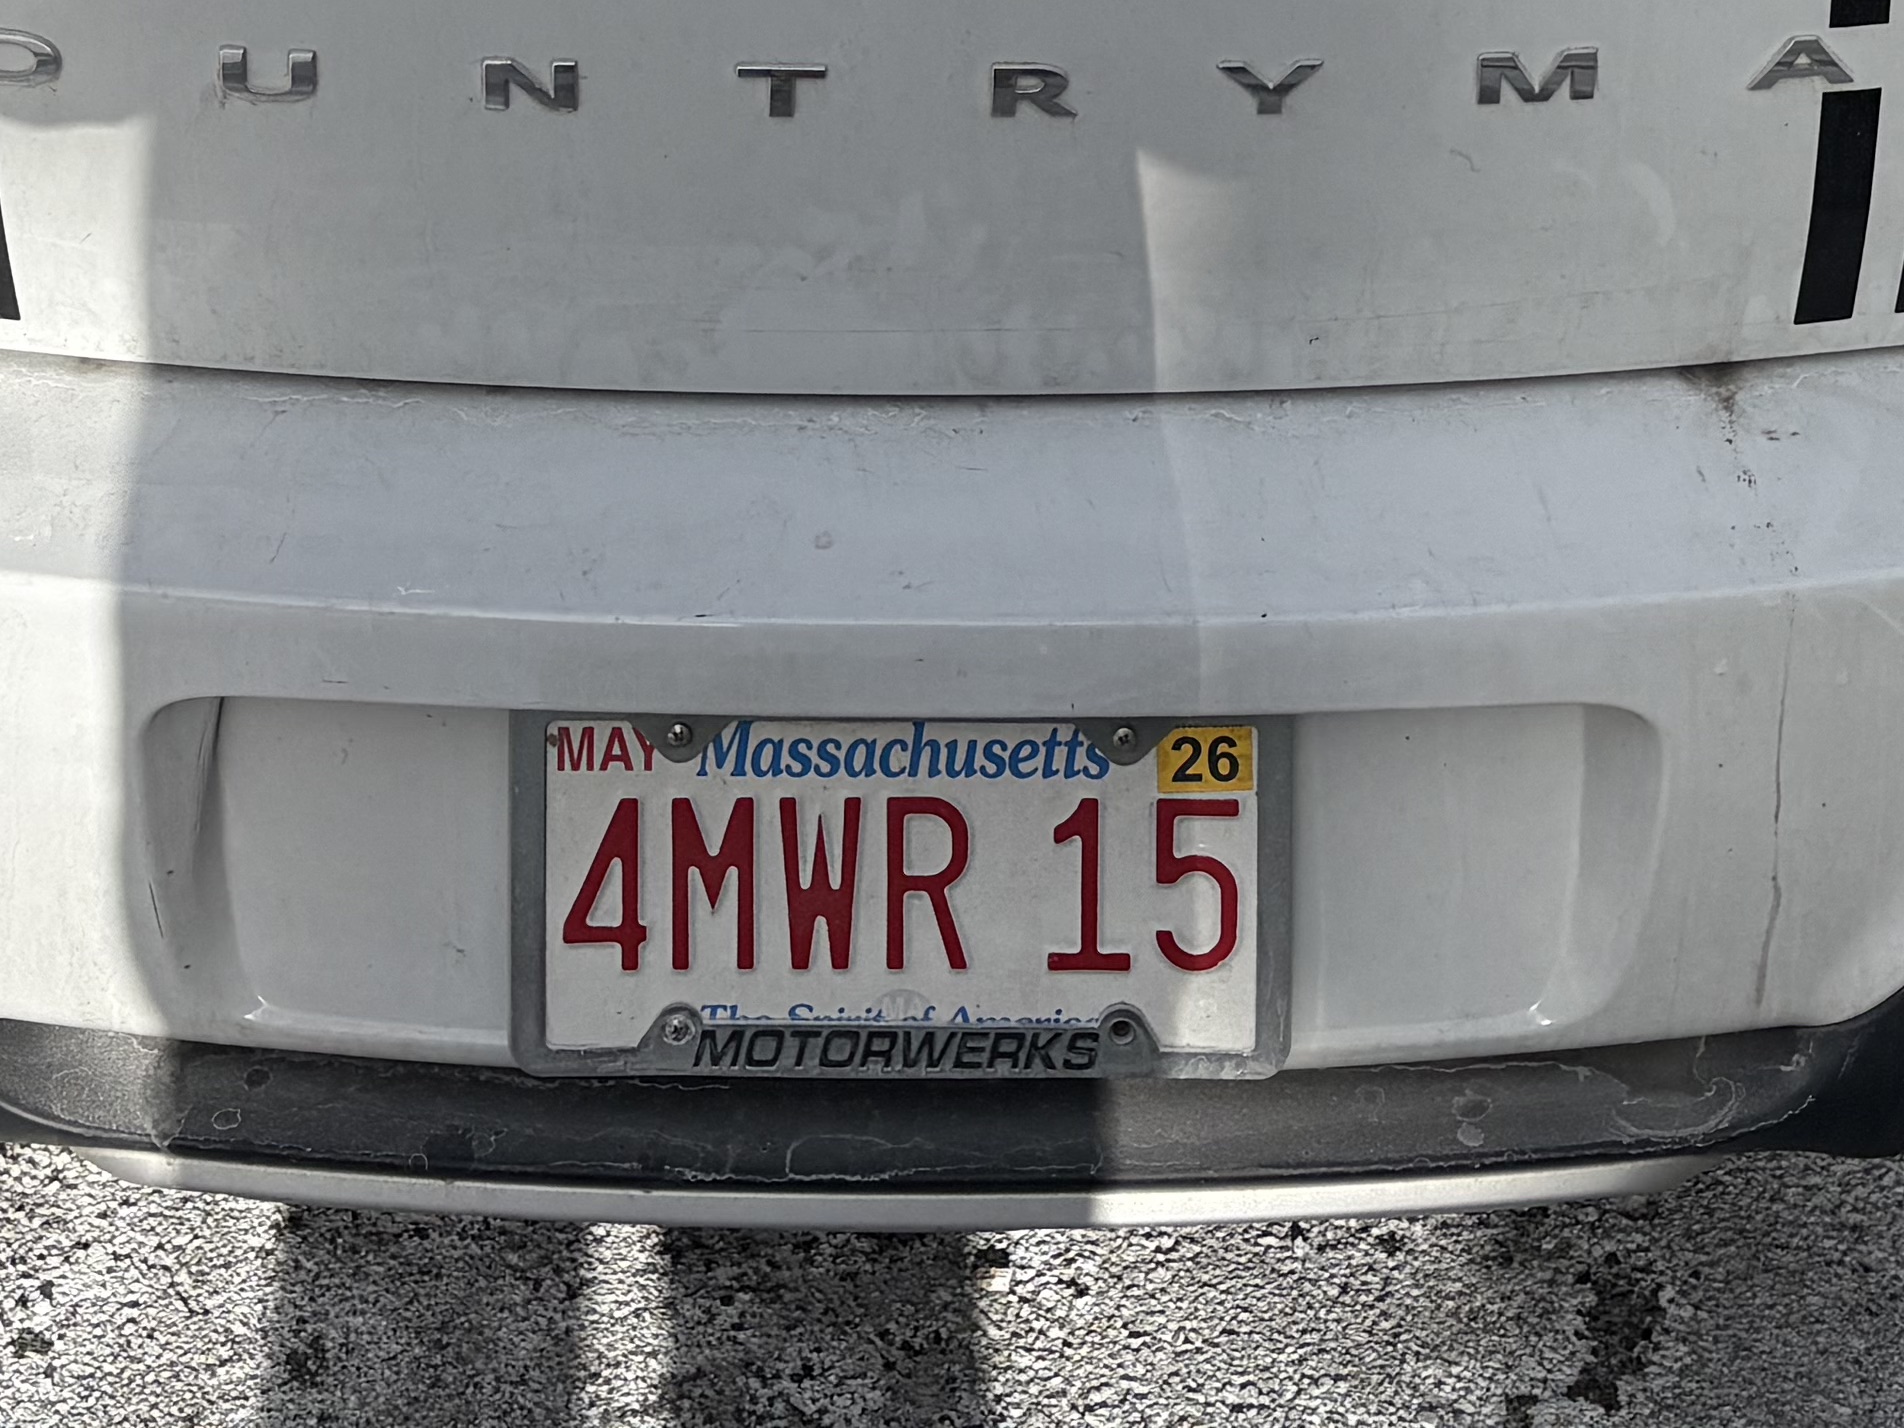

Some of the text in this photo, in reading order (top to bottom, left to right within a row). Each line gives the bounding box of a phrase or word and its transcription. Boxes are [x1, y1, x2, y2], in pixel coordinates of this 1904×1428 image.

[556, 726, 659, 772] MAY
[696, 720, 1110, 780] Massachusetts
[1171, 735, 1240, 784] 26
[562, 796, 1240, 972] 4MWR 15
[693, 1028, 1101, 1070] MOTORWERKS
